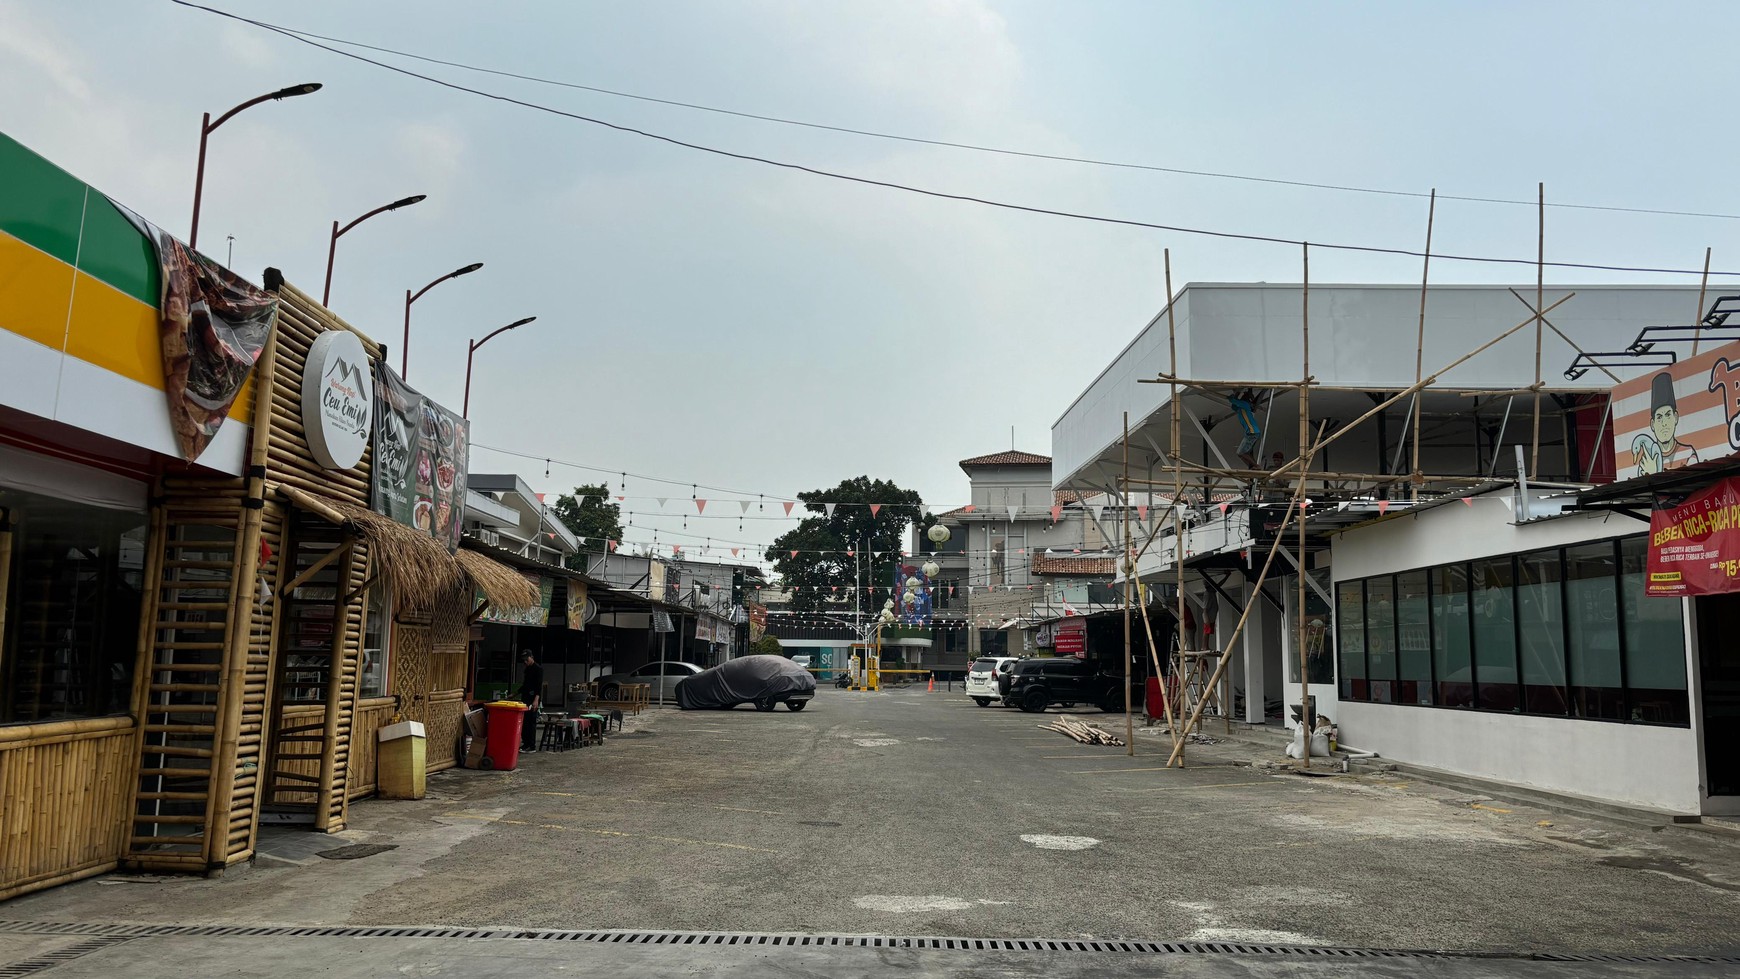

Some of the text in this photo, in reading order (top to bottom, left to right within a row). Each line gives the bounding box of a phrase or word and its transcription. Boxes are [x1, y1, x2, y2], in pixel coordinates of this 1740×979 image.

[323, 387, 358, 420] Ceu Emi
[1672, 493, 1735, 523] MENU BARU
[1683, 506, 1730, 537] RICA-RICA
